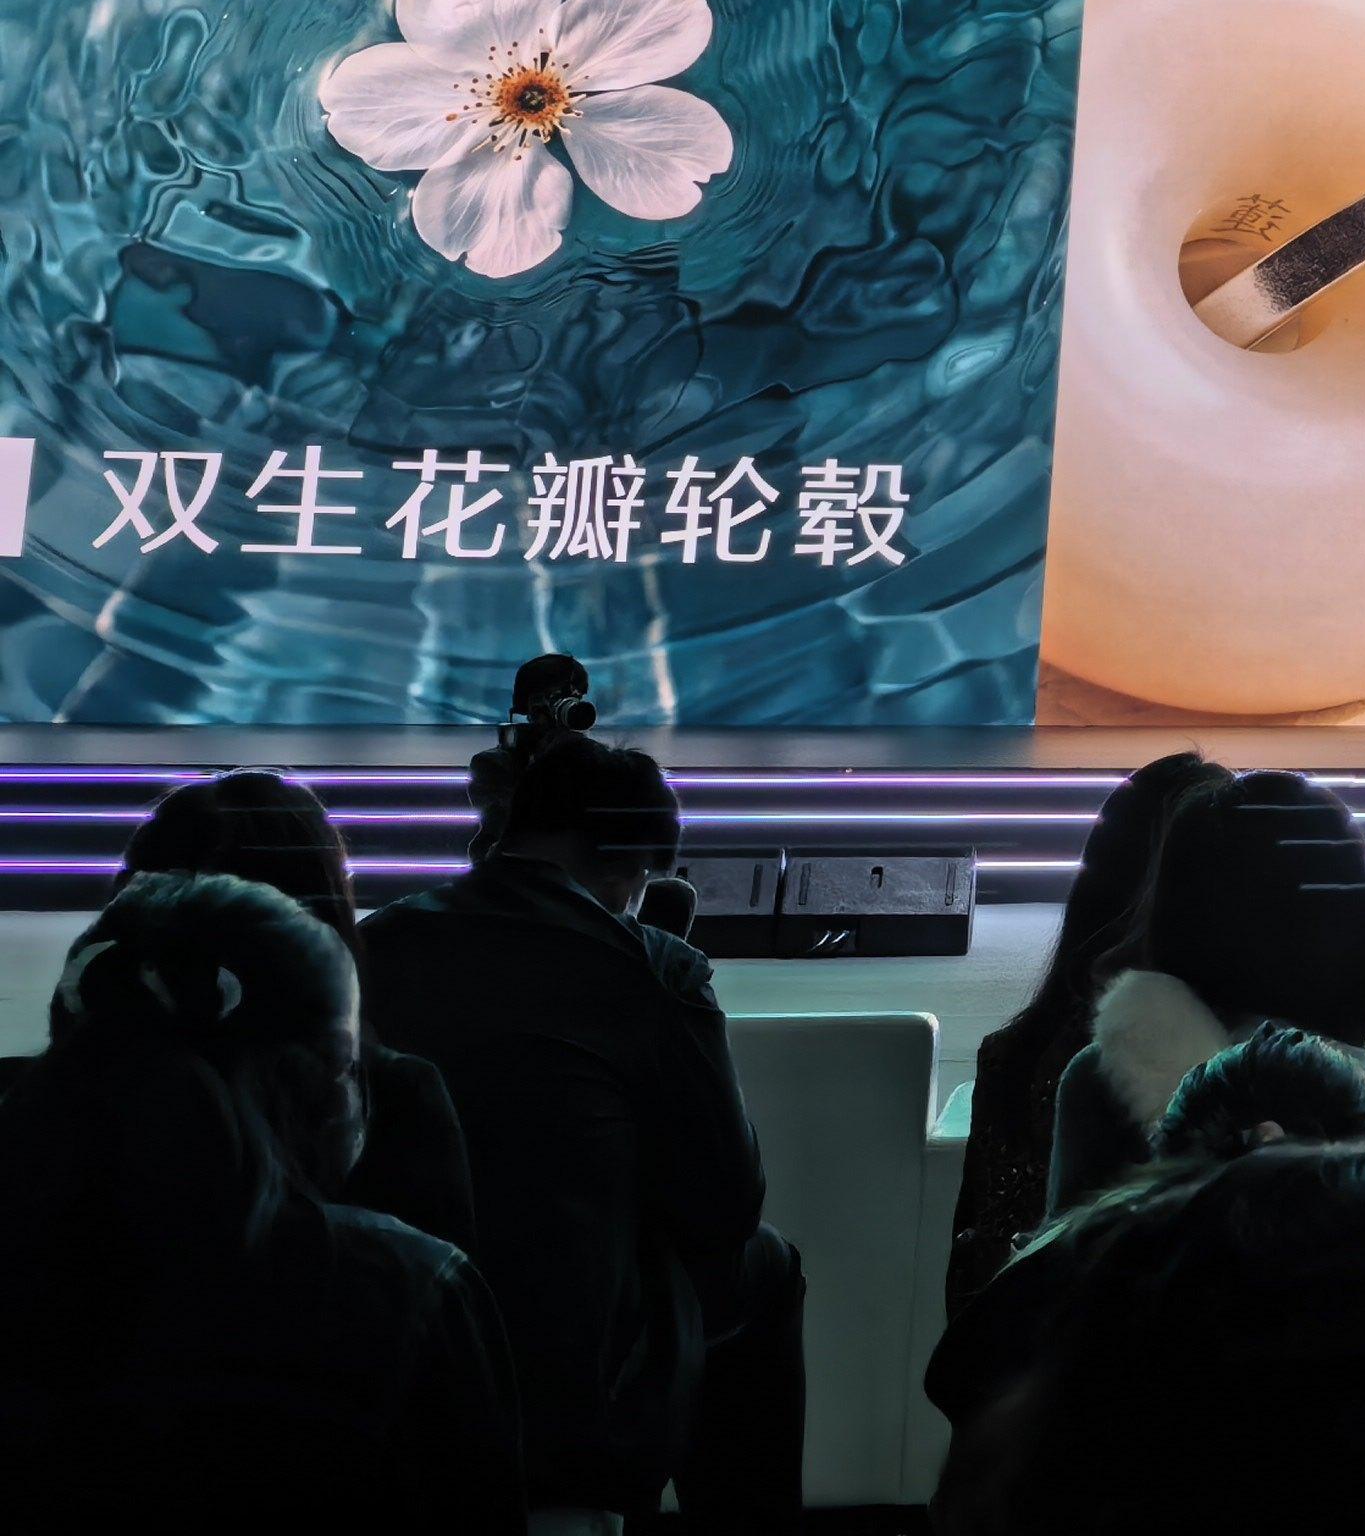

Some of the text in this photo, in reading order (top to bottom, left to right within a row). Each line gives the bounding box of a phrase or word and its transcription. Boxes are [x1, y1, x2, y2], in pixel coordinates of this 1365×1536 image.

[91, 444, 909, 567] 双生花瓣轮毂
